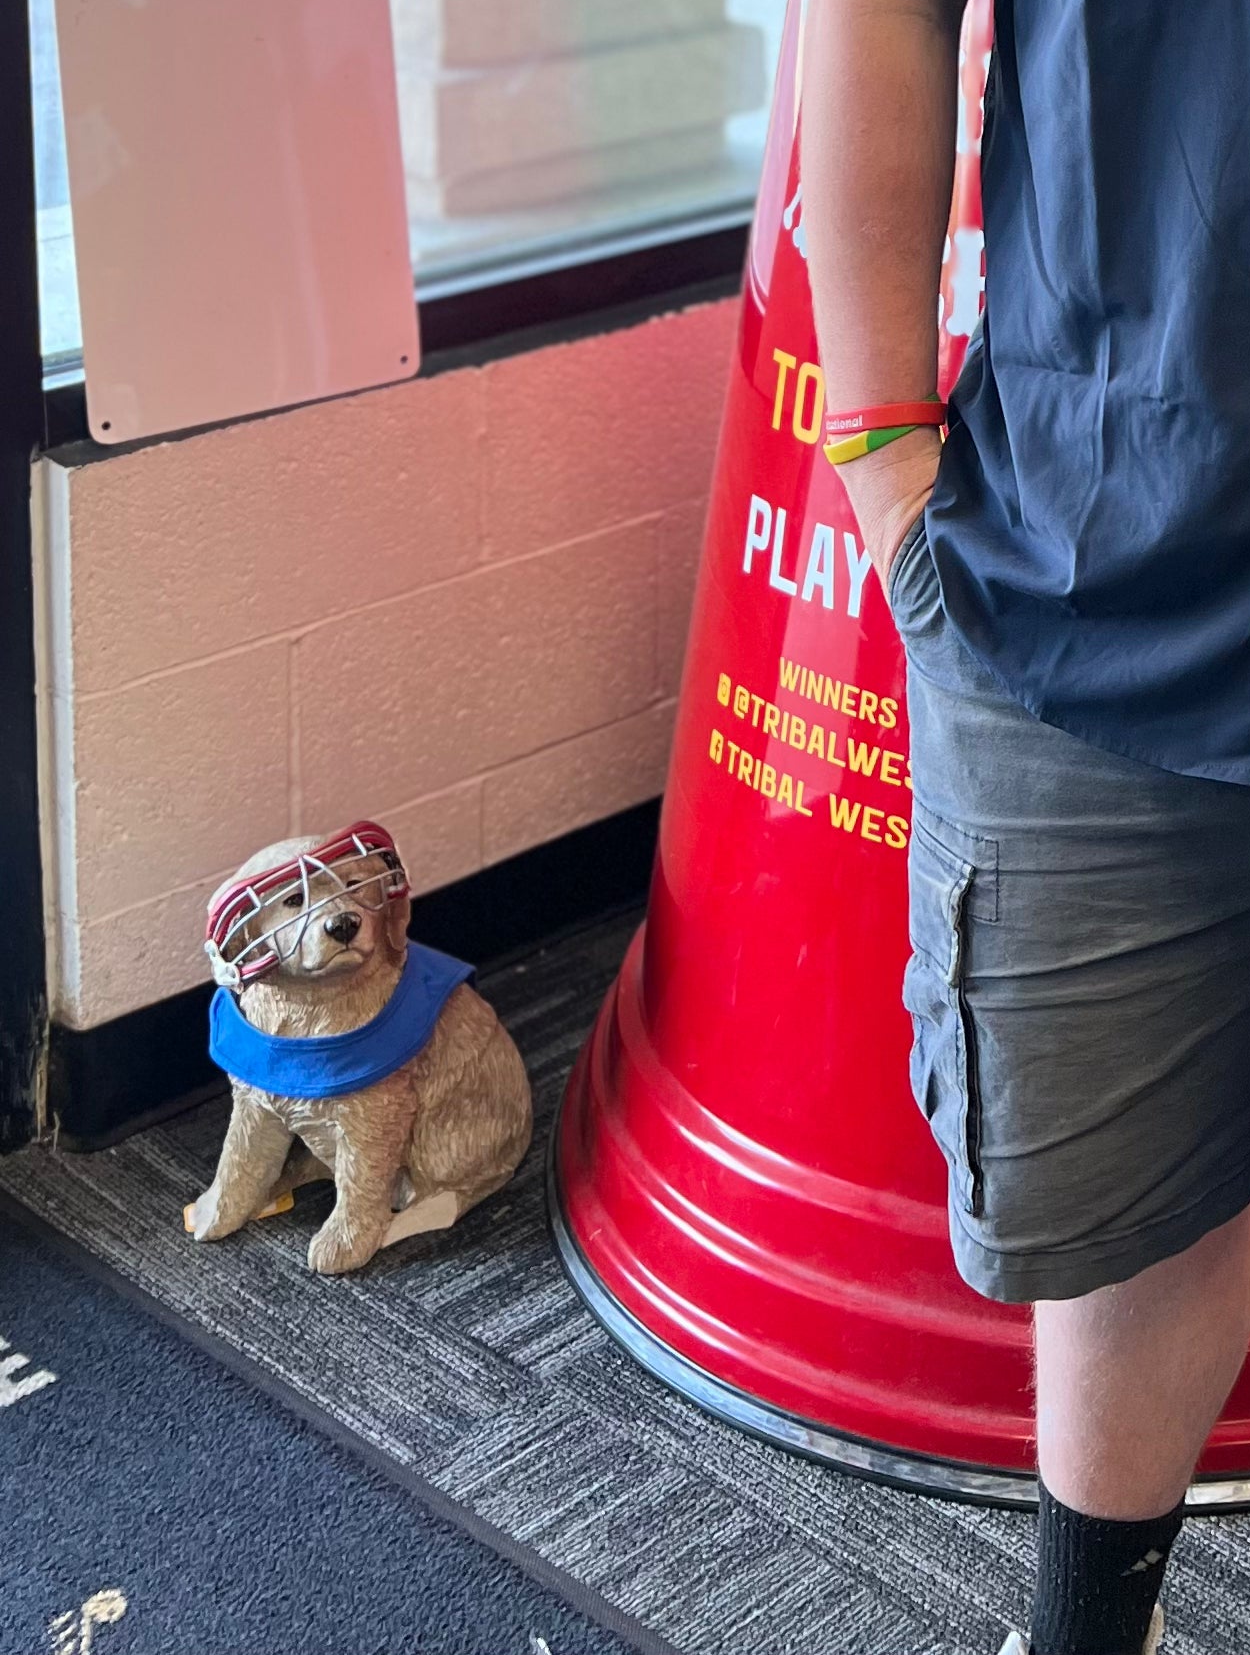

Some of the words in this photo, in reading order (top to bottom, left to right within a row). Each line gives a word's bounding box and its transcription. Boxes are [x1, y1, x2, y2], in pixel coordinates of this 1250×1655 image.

[743, 494, 873, 618] PLAY
[779, 656, 898, 729] WINNERS
[727, 740, 813, 817] TRIBAL
[829, 793, 909, 849] WES
